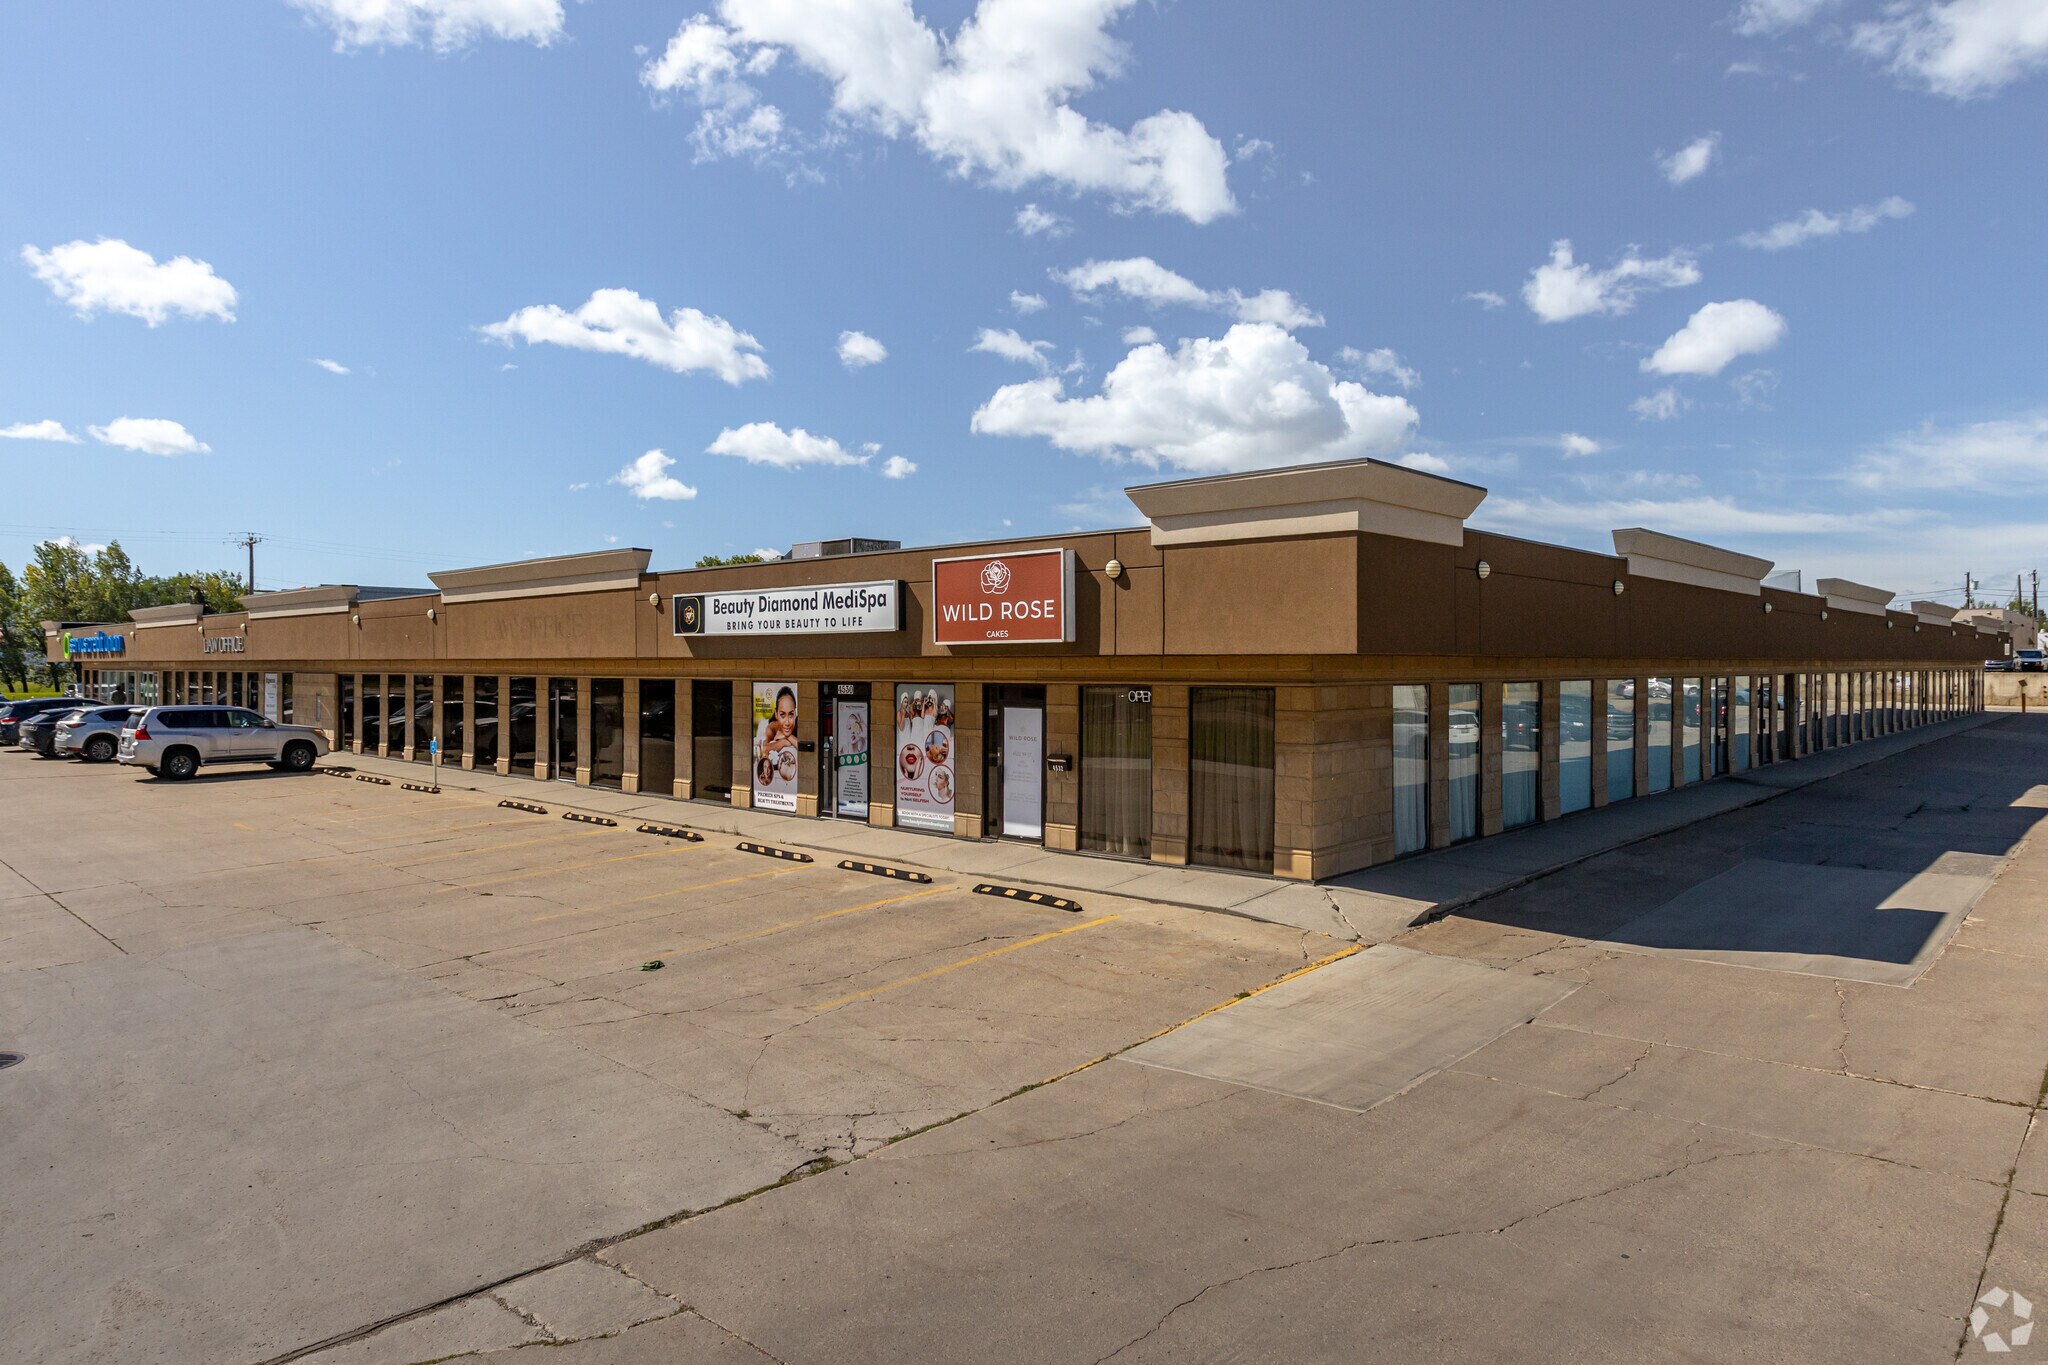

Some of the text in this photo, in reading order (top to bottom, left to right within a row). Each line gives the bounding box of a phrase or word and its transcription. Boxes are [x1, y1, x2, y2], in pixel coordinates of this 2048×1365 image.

[713, 589, 887, 617] Beauty Diamond MediSpa
[942, 599, 1055, 622] WILD ROSE
[726, 616, 863, 631] BRING YOUR BEAUTY TO LIFE
[986, 630, 1009, 638] CAKES
[203, 636, 245, 653] LAW OFFICE
